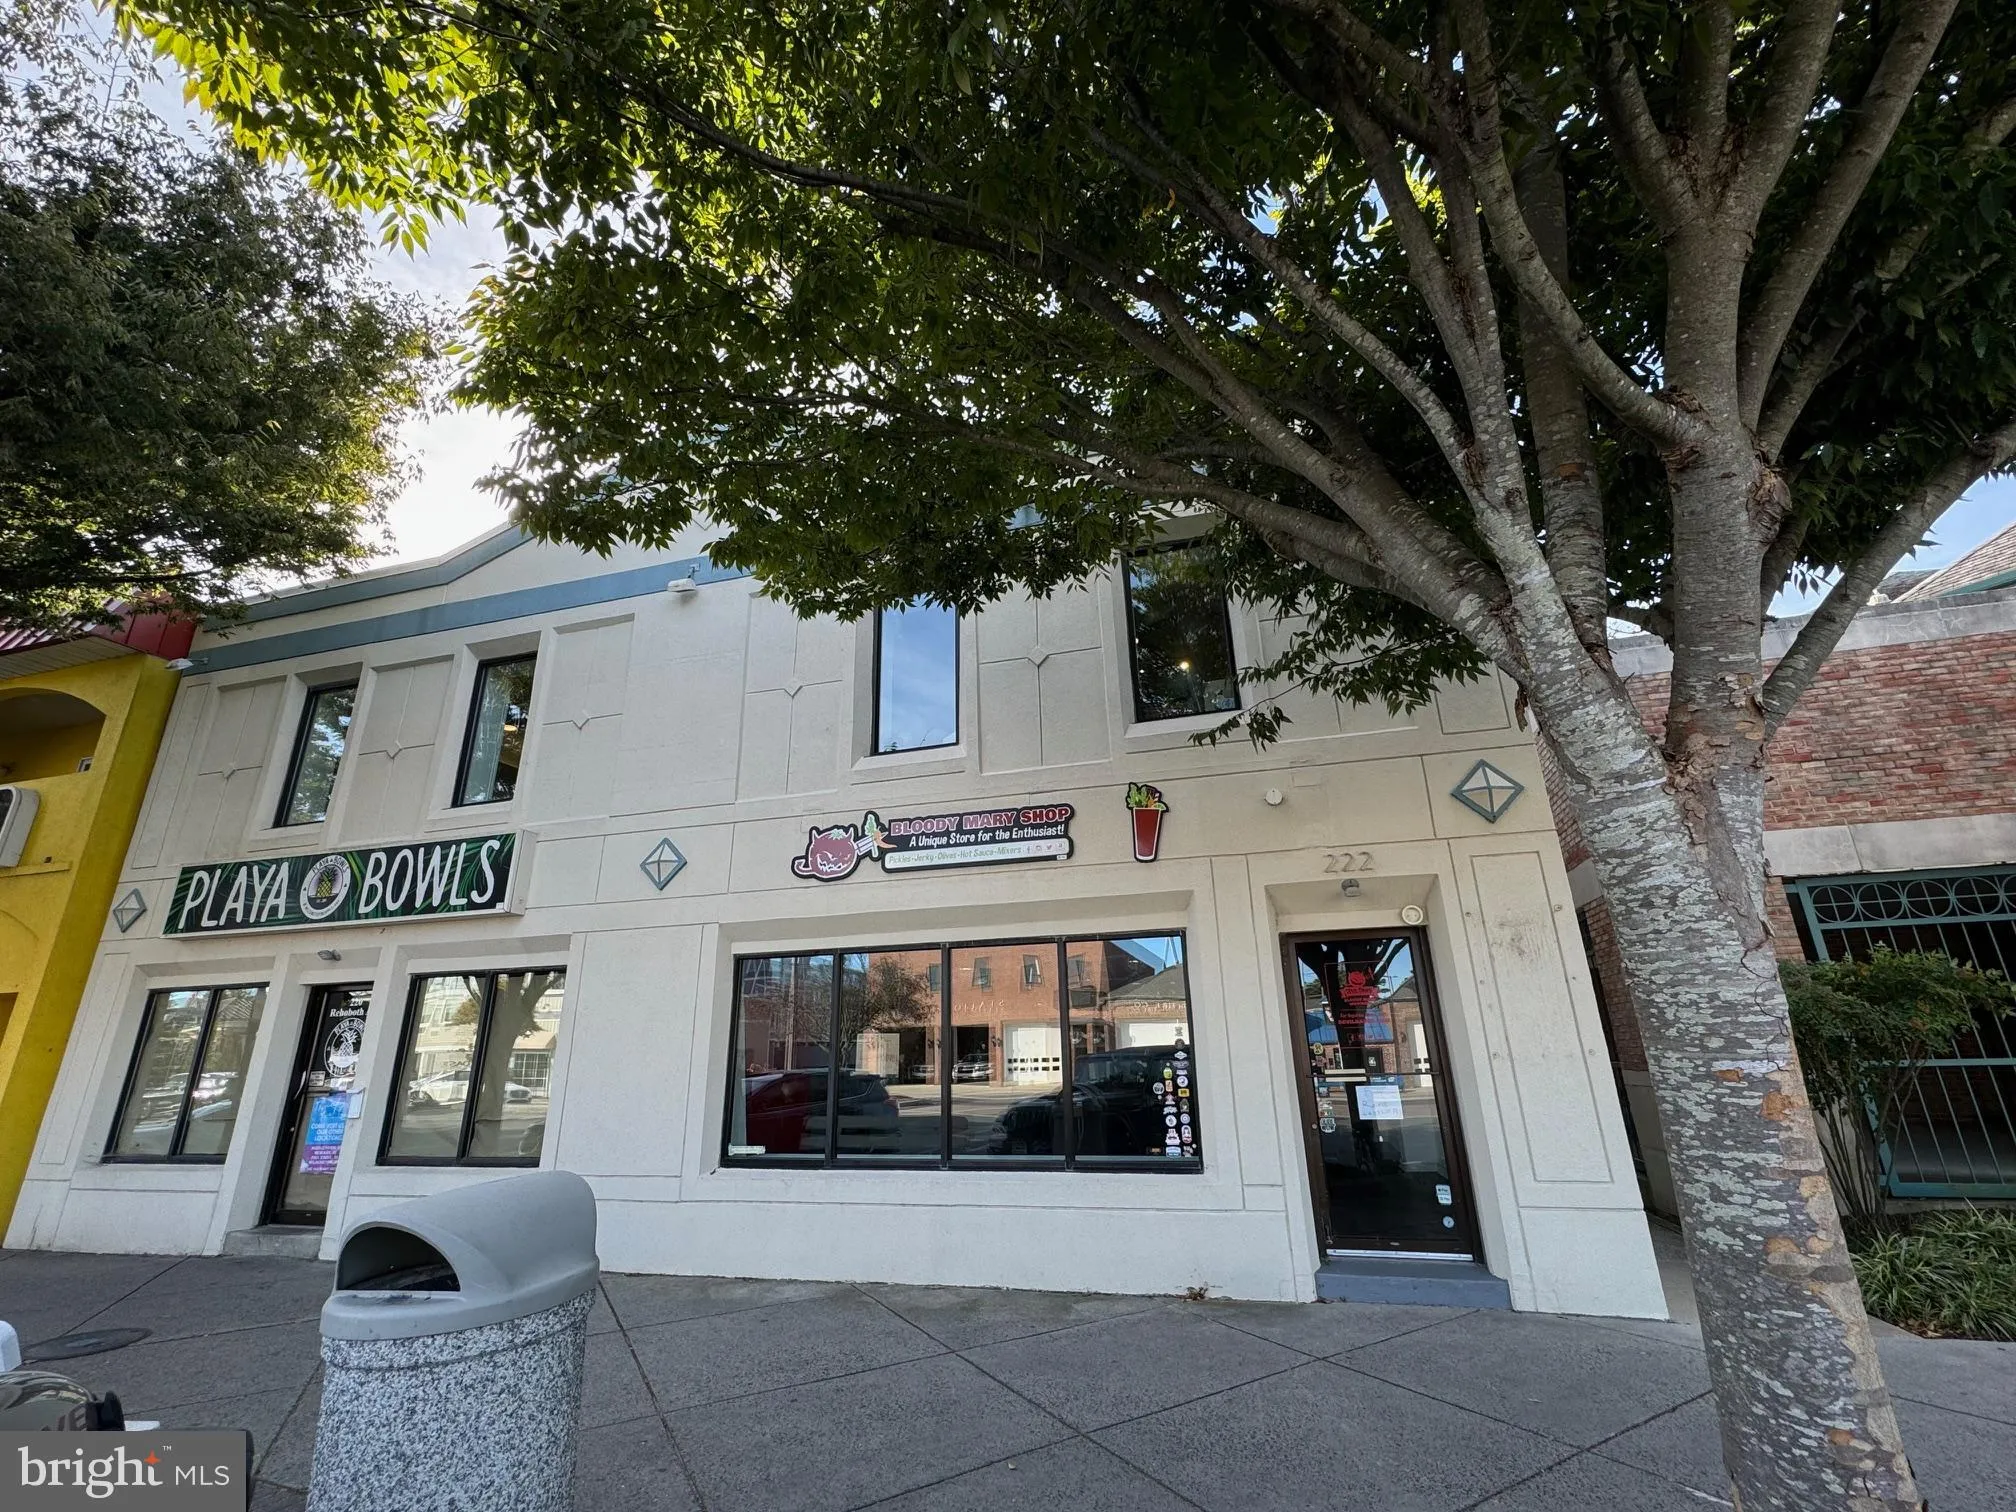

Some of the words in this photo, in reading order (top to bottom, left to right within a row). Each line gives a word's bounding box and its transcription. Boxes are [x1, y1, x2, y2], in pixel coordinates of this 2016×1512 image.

[890, 816, 960, 836] BLOODY
[963, 811, 1016, 830] MARY
[1020, 807, 1071, 825] SHOP
[909, 836, 917, 848] A
[918, 835, 948, 848] Unique
[949, 832, 975, 844] Store
[977, 830, 993, 842] for
[995, 828, 1010, 840] the
[1012, 824, 1065, 839] Enthusiast!
[1322, 851, 1374, 873] 222
[178, 861, 289, 930] PLAYA
[358, 839, 500, 914] BOWLS
[329, 1007, 364, 1018] Rehoboth
